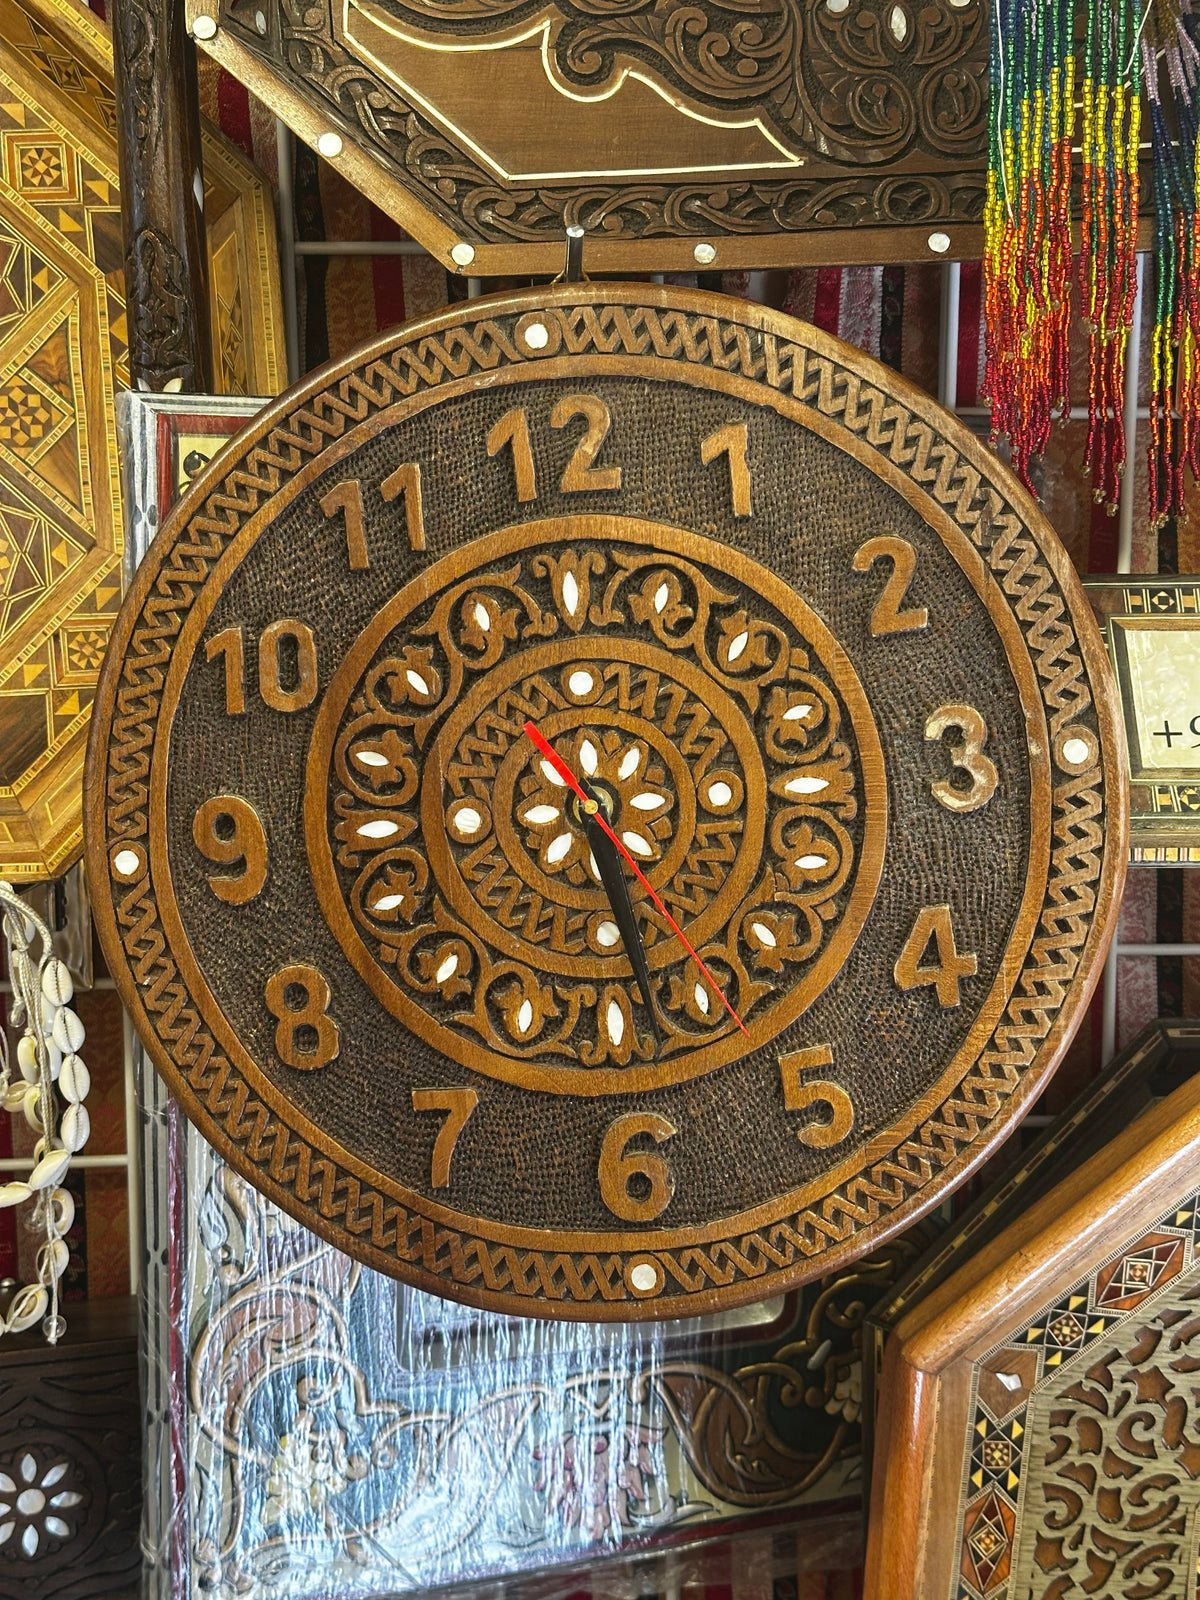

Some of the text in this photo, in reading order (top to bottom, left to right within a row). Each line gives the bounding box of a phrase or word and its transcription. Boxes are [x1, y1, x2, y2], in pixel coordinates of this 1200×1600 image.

[487, 395, 622, 502] 12
[702, 424, 752, 517] 1
[320, 463, 427, 570] 11
[853, 536, 929, 636] 2
[204, 619, 318, 714] 10
[925, 706, 998, 812] 3
[193, 796, 268, 904] 9
[895, 905, 977, 1007] 4
[265, 965, 339, 1070] 8
[412, 1089, 479, 1189] 7
[779, 1044, 854, 1149] 5
[599, 1113, 677, 1222] 6
